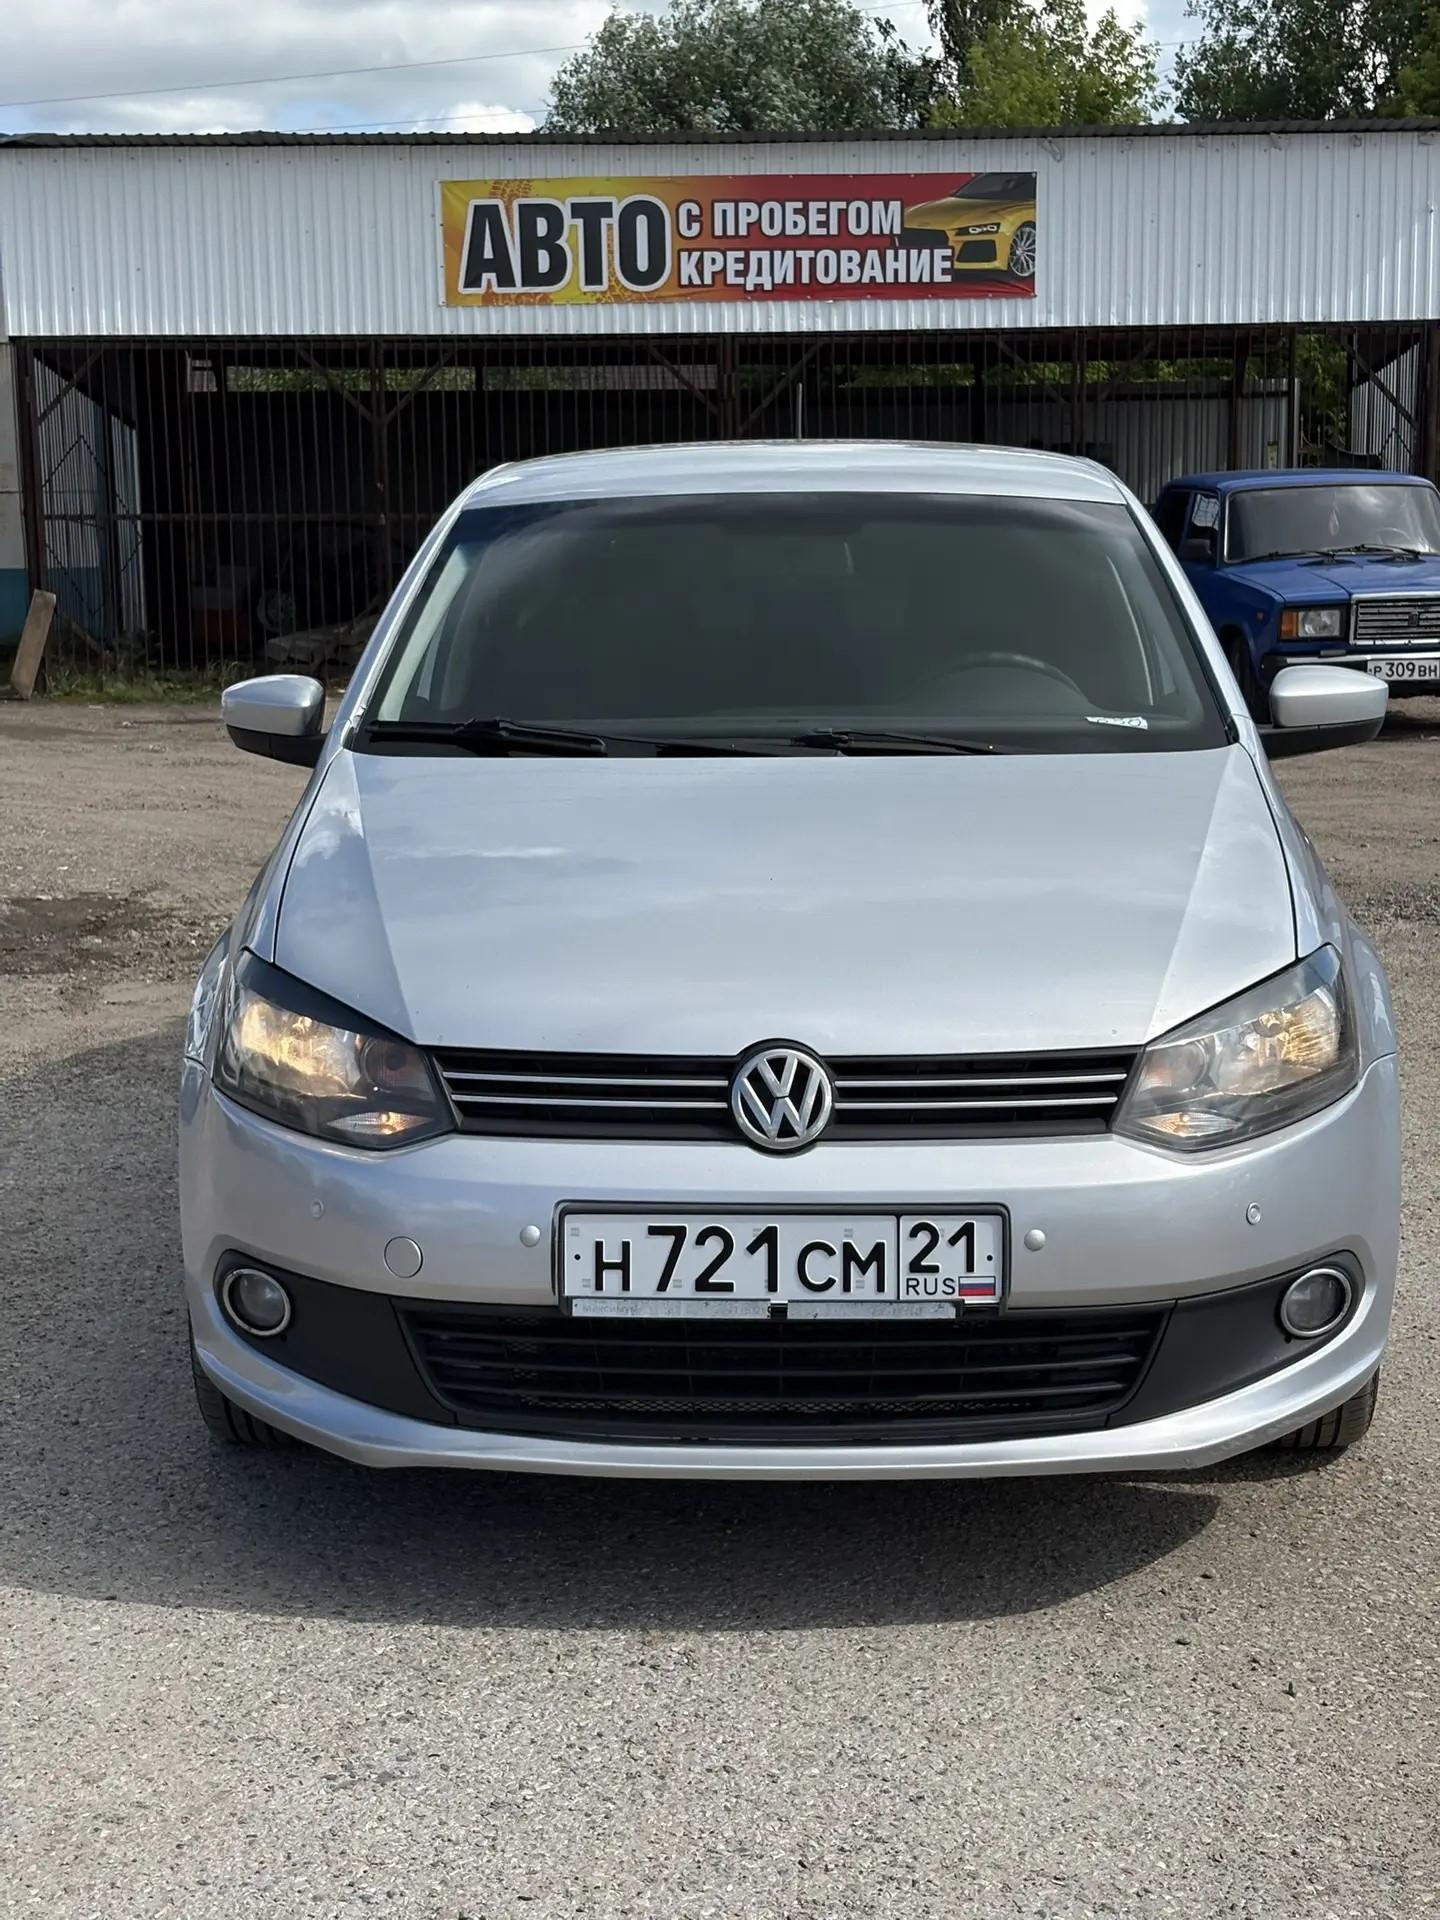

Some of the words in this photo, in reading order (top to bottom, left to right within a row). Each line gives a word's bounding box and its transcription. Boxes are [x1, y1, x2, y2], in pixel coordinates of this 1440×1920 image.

[678, 202, 701, 237] С
[714, 200, 901, 236] ПРОБЕГОМ
[459, 195, 671, 293] АВТО
[680, 249, 952, 291] КРЕДИТОВАНИЕ
[908, 1221, 976, 1273] 21
[906, 1277, 956, 1296] RUS
